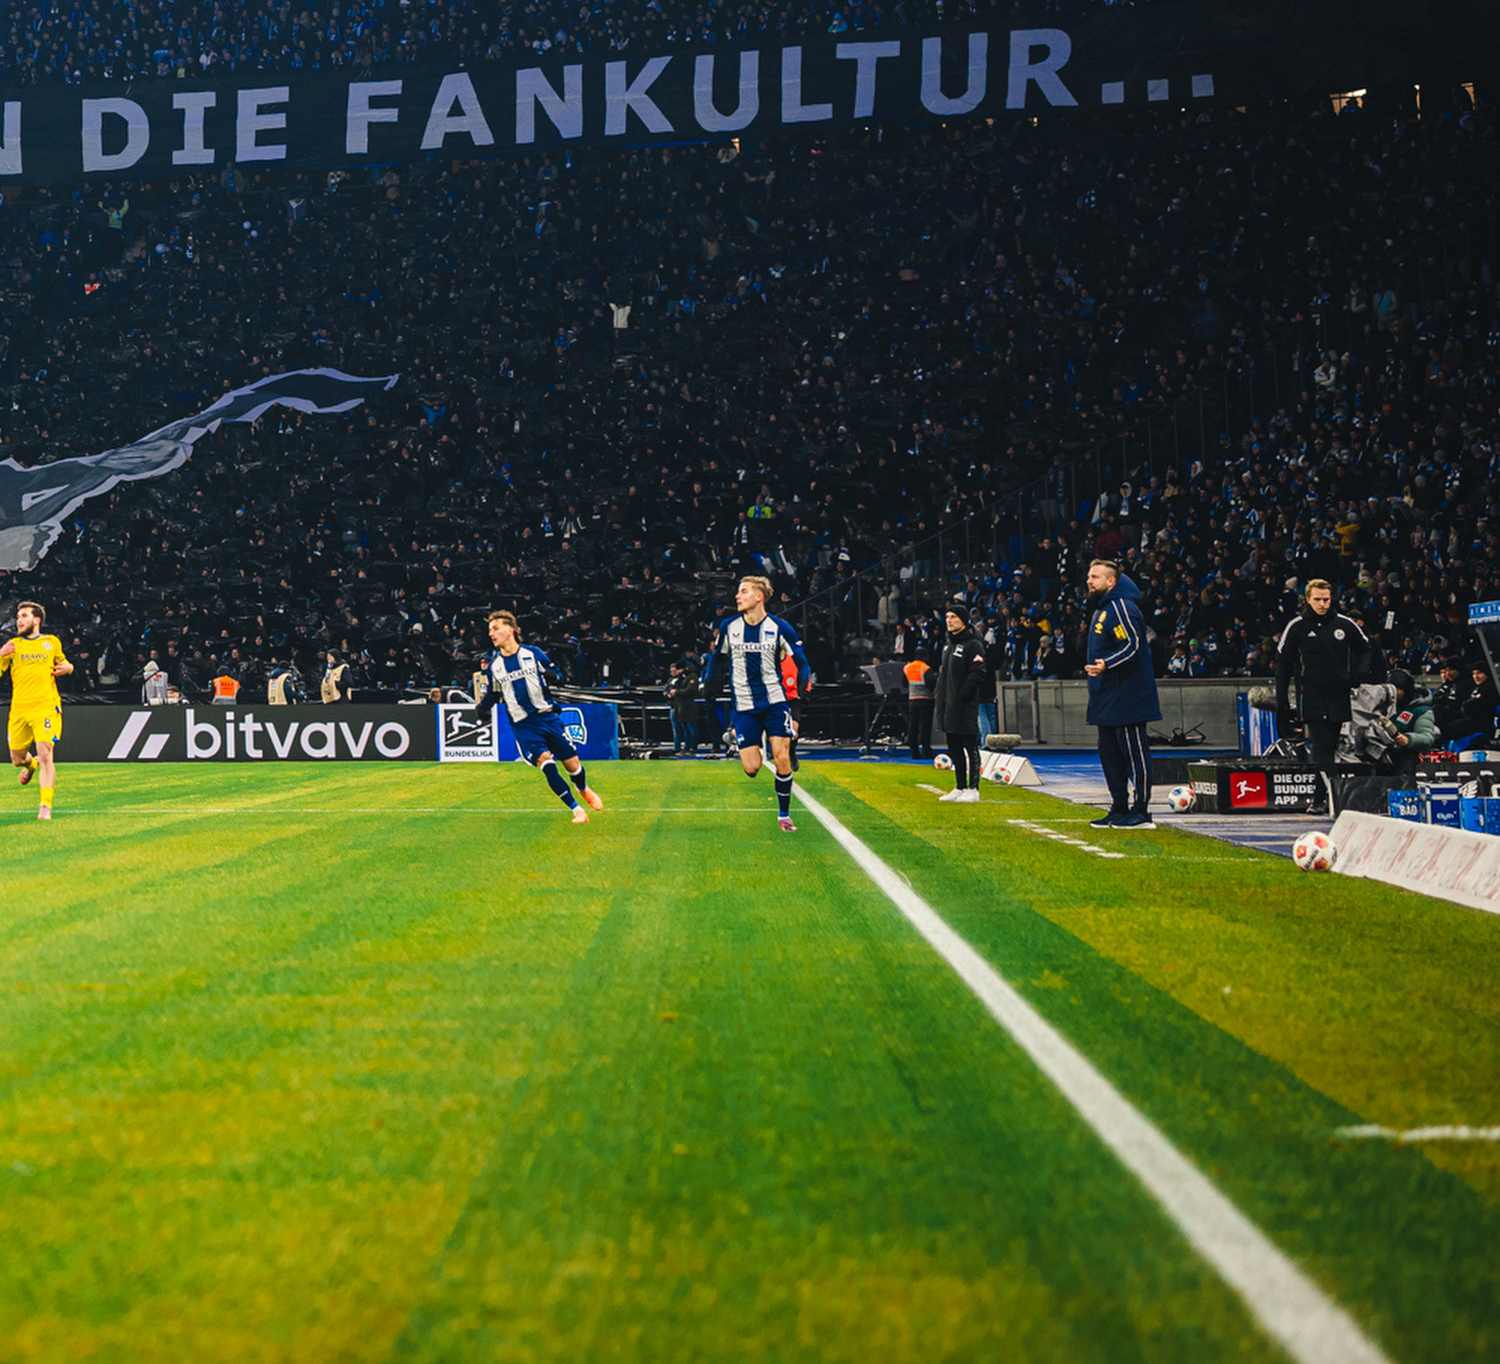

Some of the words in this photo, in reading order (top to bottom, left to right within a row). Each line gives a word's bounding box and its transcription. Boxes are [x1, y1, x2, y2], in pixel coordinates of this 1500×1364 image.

[81, 86, 290, 172] DIE
[345, 28, 1214, 155] FANKULTUR...
[43, 719, 51, 729] 8
[185, 708, 410, 759] bitvavo
[444, 750, 494, 758] BUNDESLIGA
[1273, 774, 1292, 783] DIE
[1293, 774, 1315, 783] OFF
[1274, 785, 1316, 794] BUNDE
[1275, 796, 1298, 805] APP
